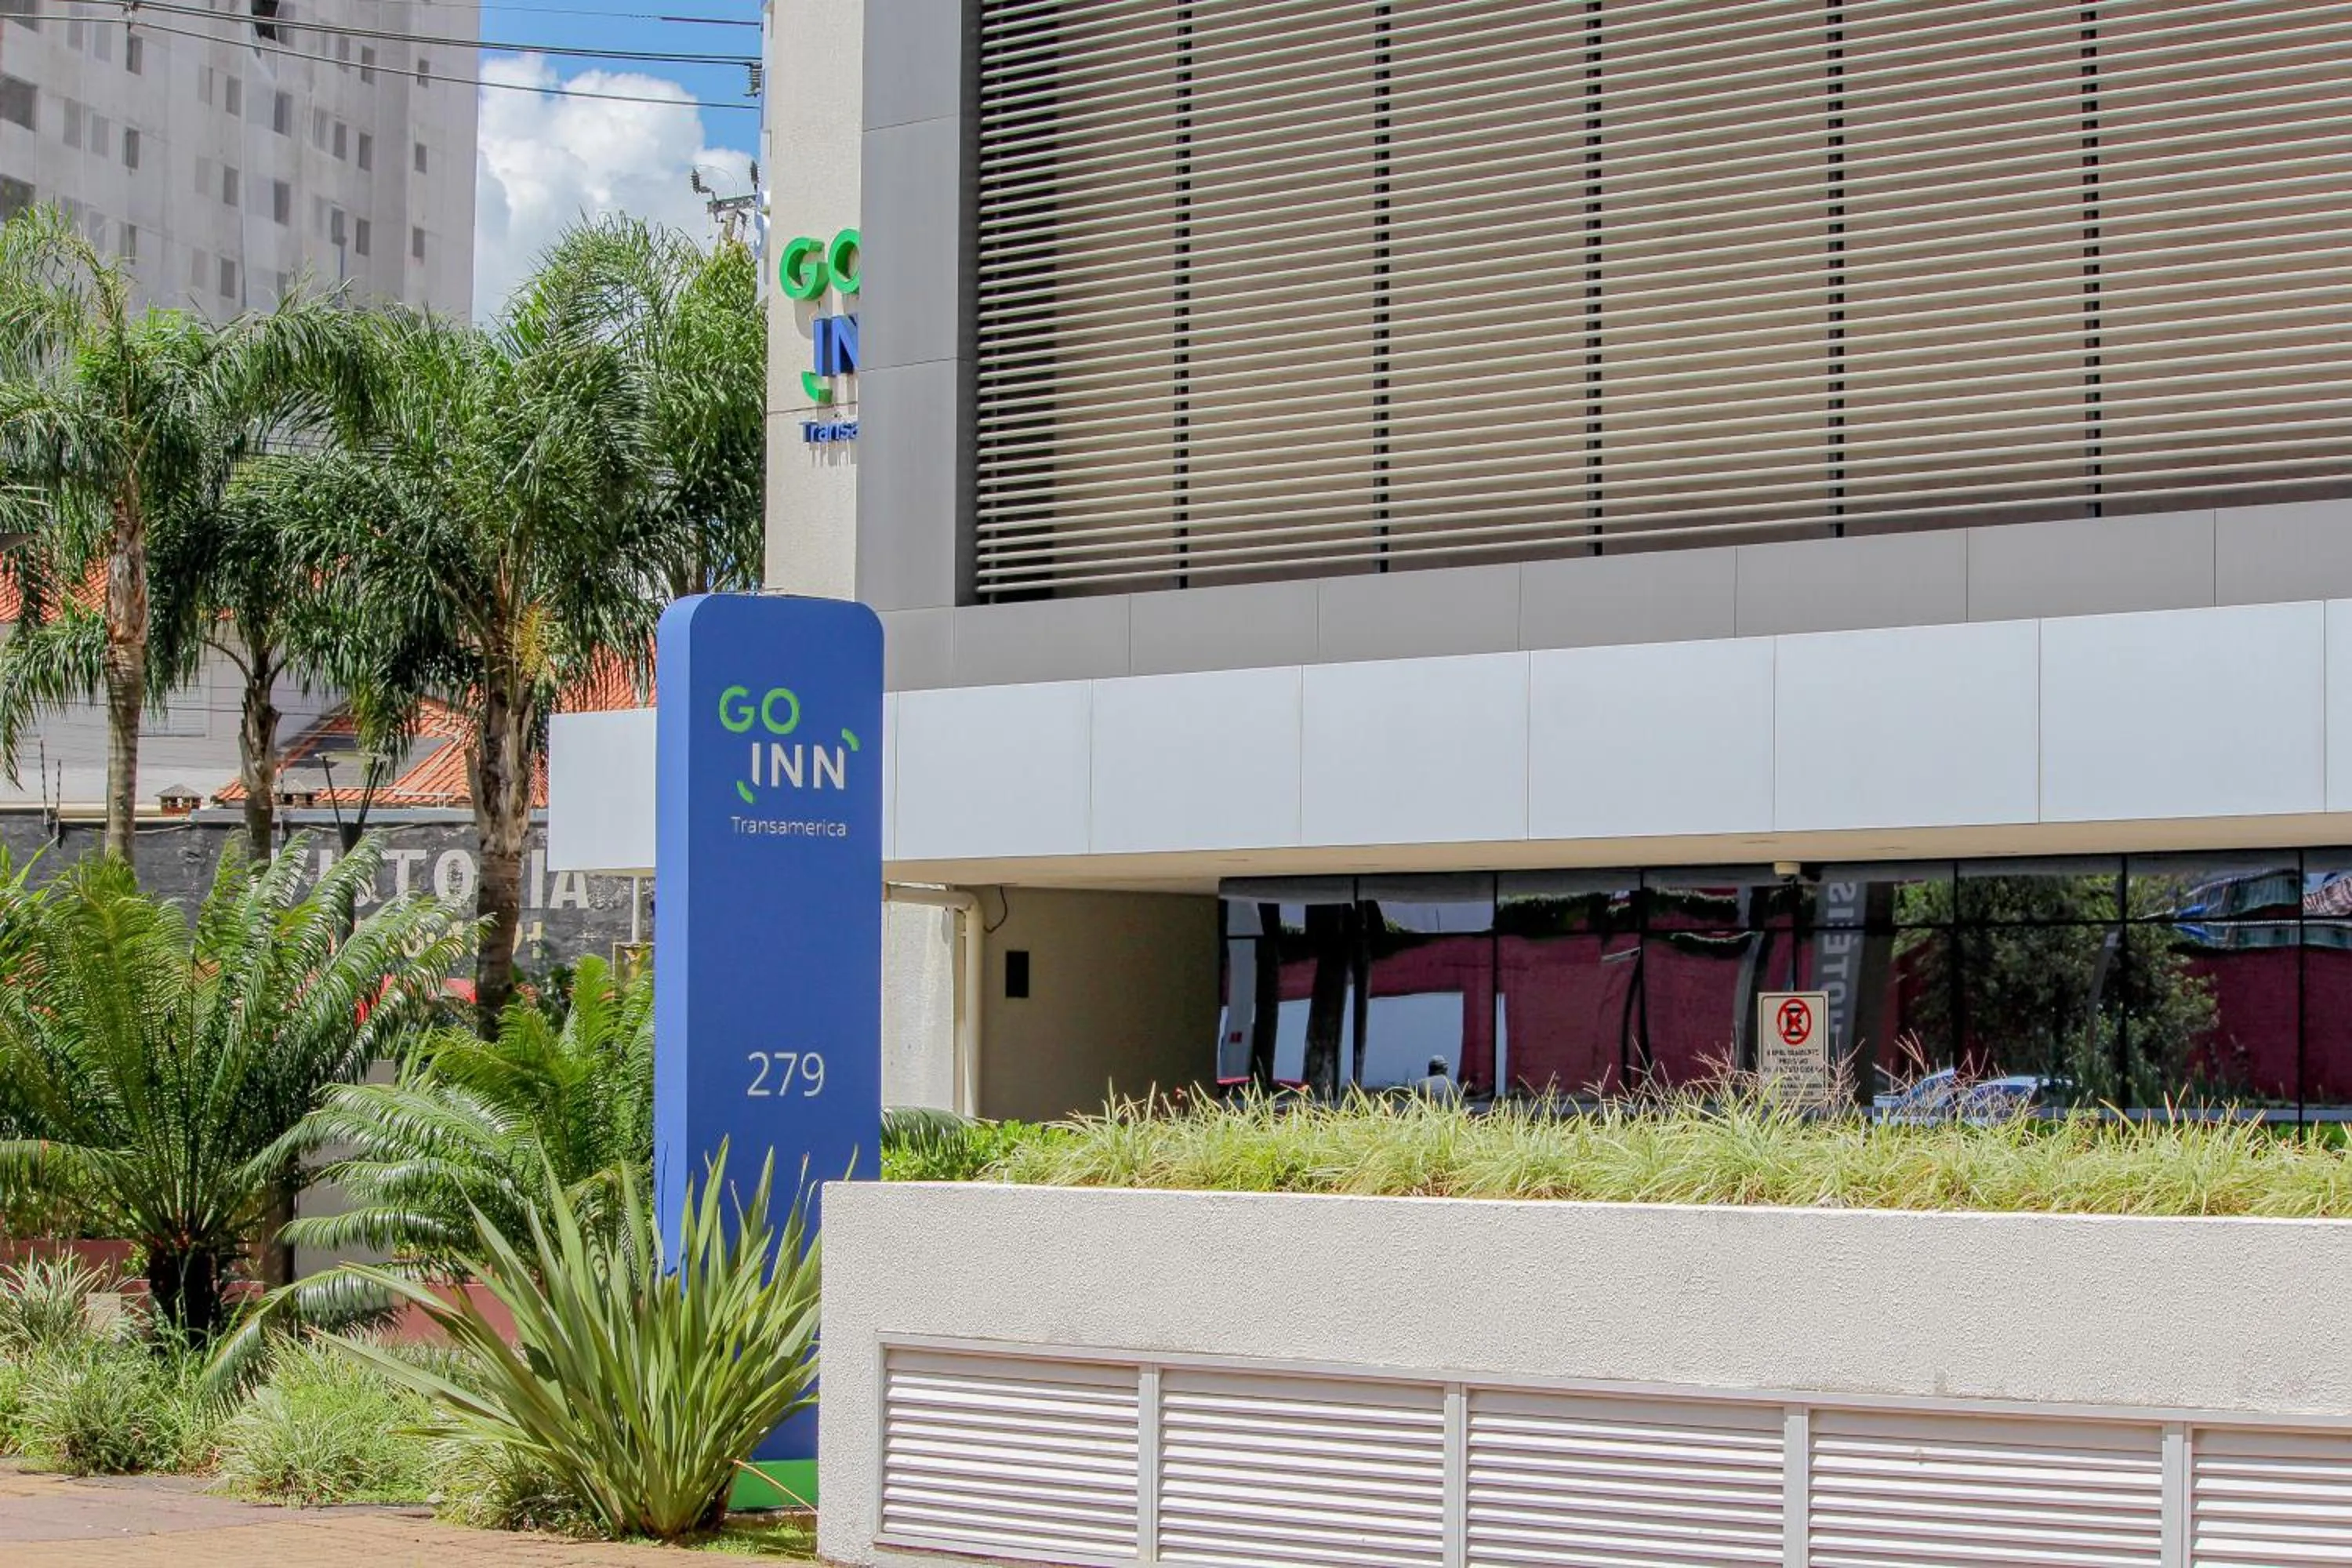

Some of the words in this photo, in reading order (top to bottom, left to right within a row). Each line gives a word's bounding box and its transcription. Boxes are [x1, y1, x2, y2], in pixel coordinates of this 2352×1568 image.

[779, 227, 859, 300] GO
[719, 685, 800, 735] GO
[752, 742, 844, 790] INN
[731, 816, 848, 837] Transamerica
[747, 1051, 825, 1097] 279
